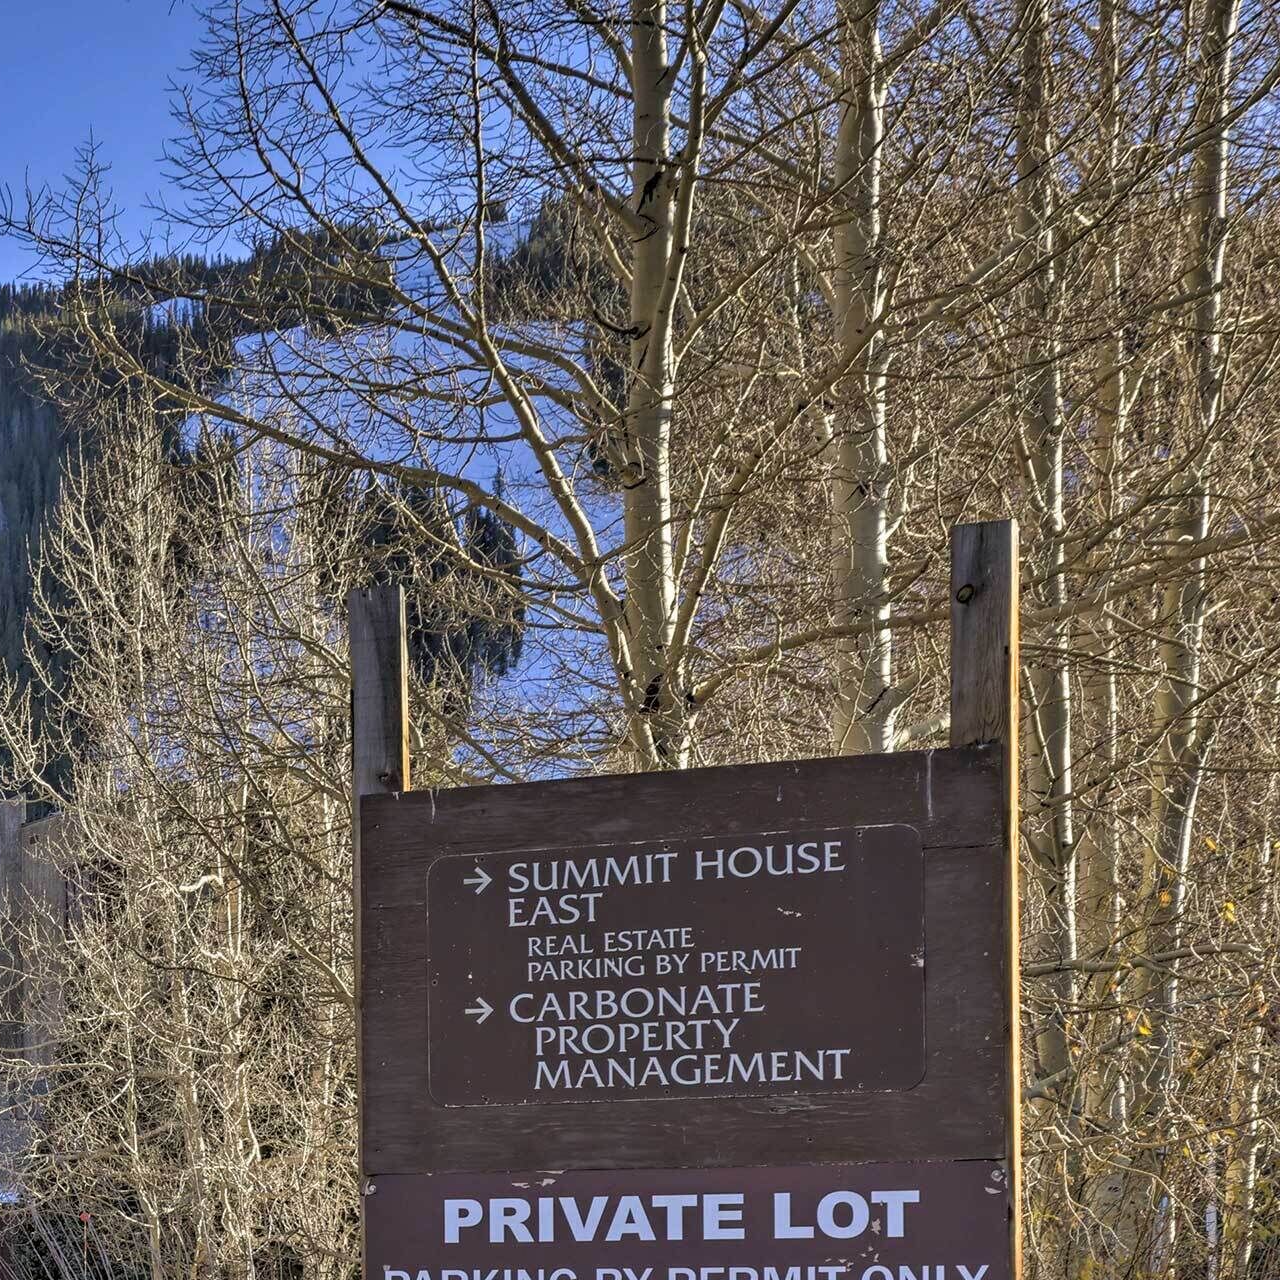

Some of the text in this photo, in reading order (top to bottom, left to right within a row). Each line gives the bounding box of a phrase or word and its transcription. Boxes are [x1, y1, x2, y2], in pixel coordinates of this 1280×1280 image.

[508, 841, 846, 893] SUMMIT HOUSE
[508, 893, 603, 928] EAST
[528, 928, 695, 956] REAL ESTATE
[528, 947, 802, 981] PARKING BY PERMIT
[510, 983, 766, 1024] CARBONATE
[536, 1018, 740, 1056] PROPERTY
[534, 1049, 851, 1090] MANAGEMENT
[444, 1190, 920, 1244] PRIVATE LOT
